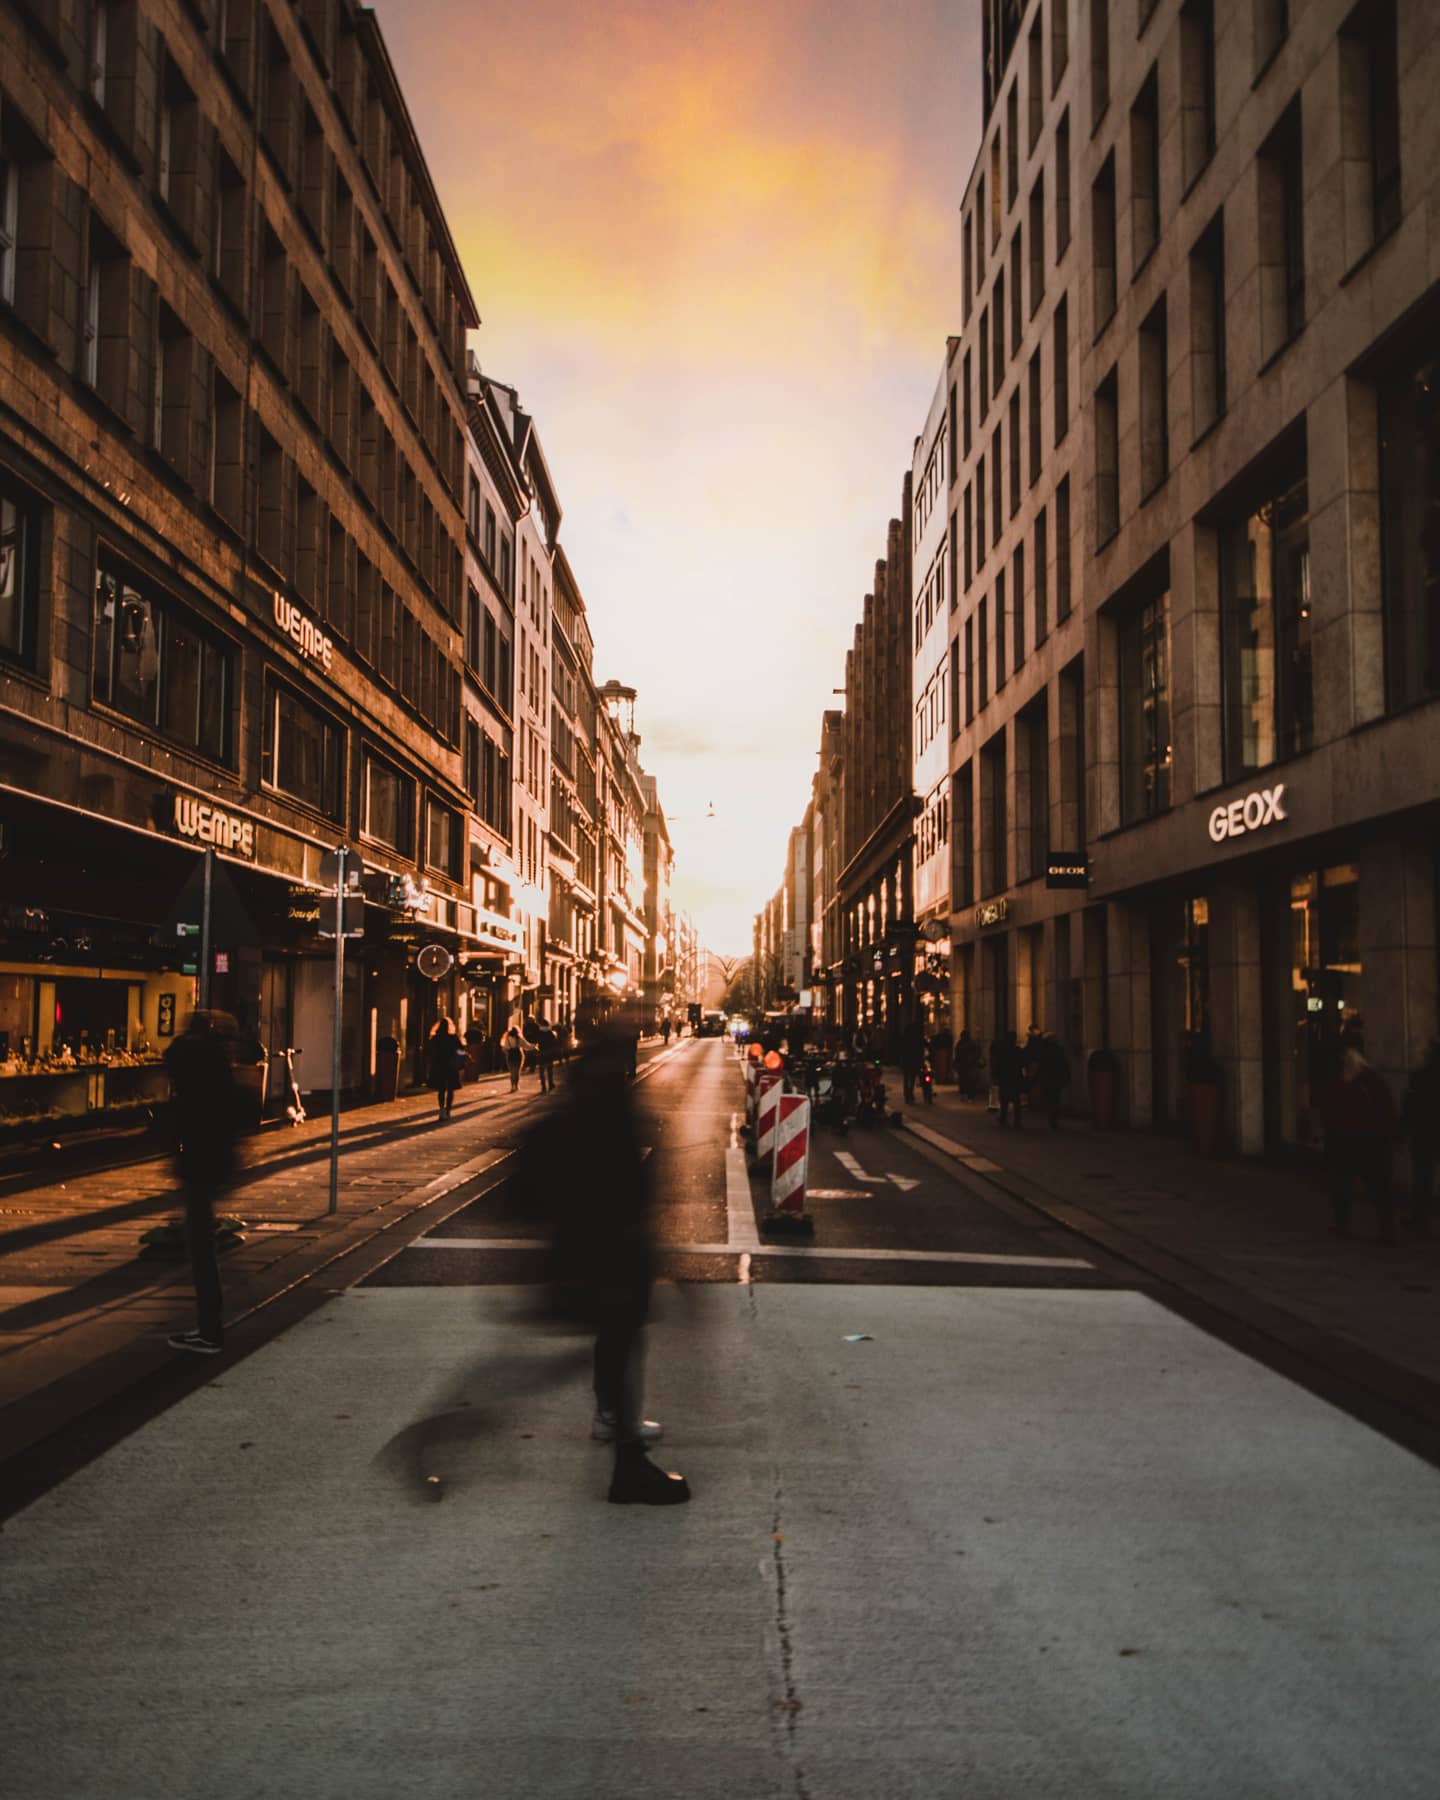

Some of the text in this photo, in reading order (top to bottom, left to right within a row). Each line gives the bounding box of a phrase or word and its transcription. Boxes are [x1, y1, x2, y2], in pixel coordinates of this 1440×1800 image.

[272, 591, 333, 670] WEMPE
[174, 796, 254, 857] WEMPE
[1207, 783, 1289, 842] GEOX
